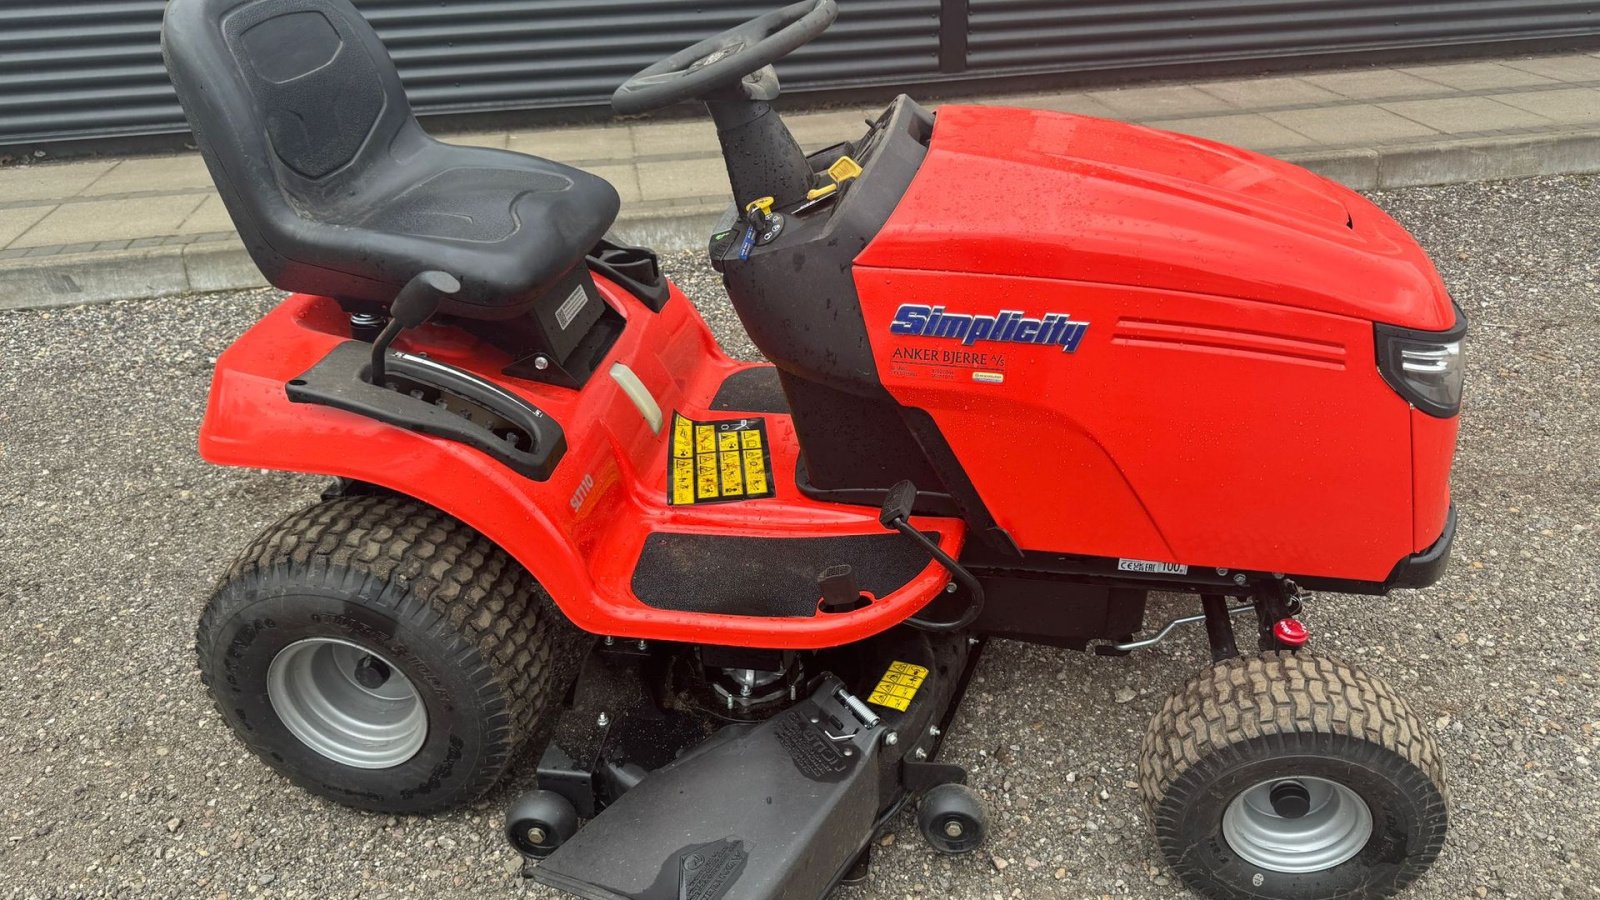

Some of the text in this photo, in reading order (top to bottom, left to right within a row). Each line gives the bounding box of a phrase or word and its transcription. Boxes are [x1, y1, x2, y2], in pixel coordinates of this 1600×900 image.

[889, 303, 1090, 353] Simplicity
[893, 347, 939, 361] ANKER
[943, 351, 987, 365] BJERRE
